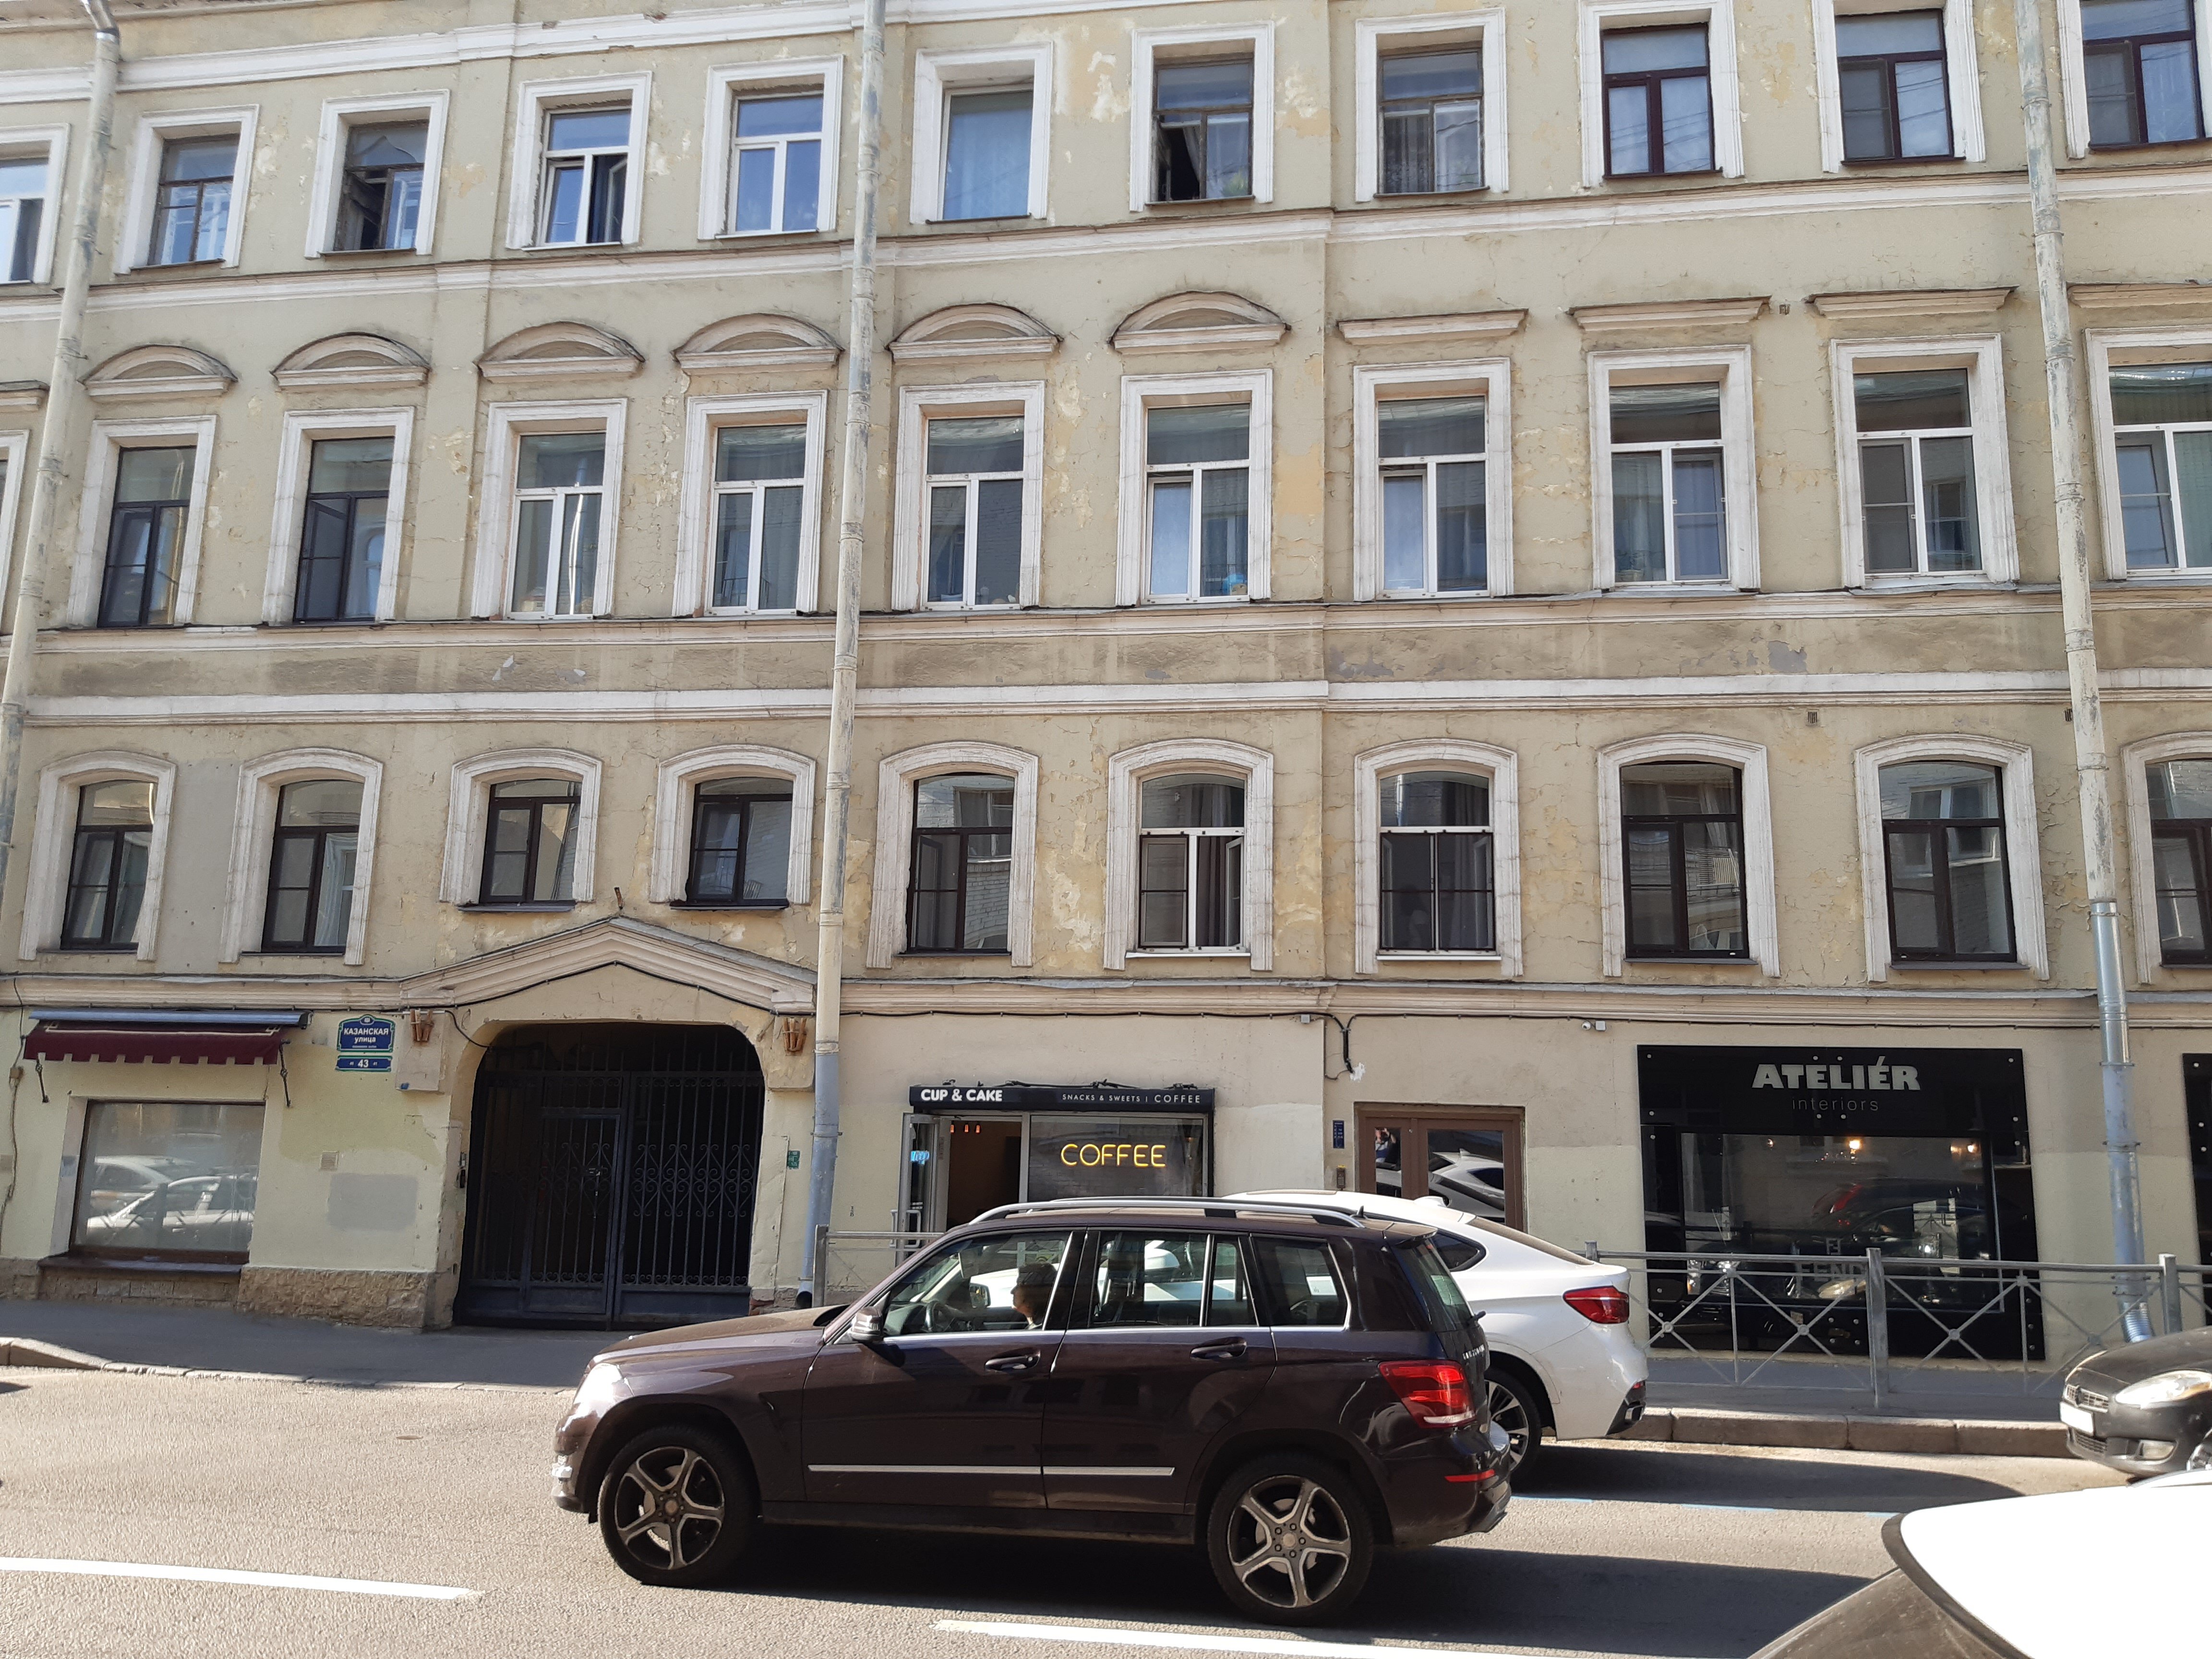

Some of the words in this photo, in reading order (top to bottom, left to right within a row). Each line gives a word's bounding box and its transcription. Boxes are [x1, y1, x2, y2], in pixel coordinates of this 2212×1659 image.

[358, 1059, 369, 1068] 43
[1752, 1056, 1921, 1090] ATELIÉR
[921, 1089, 949, 1101] CUP
[951, 1089, 962, 1101] &
[966, 1089, 1003, 1101] CAKE
[1154, 1094, 1200, 1103] COFFEE
[1792, 1097, 1879, 1111] interiors
[1061, 1143, 1166, 1167] COFFEE
